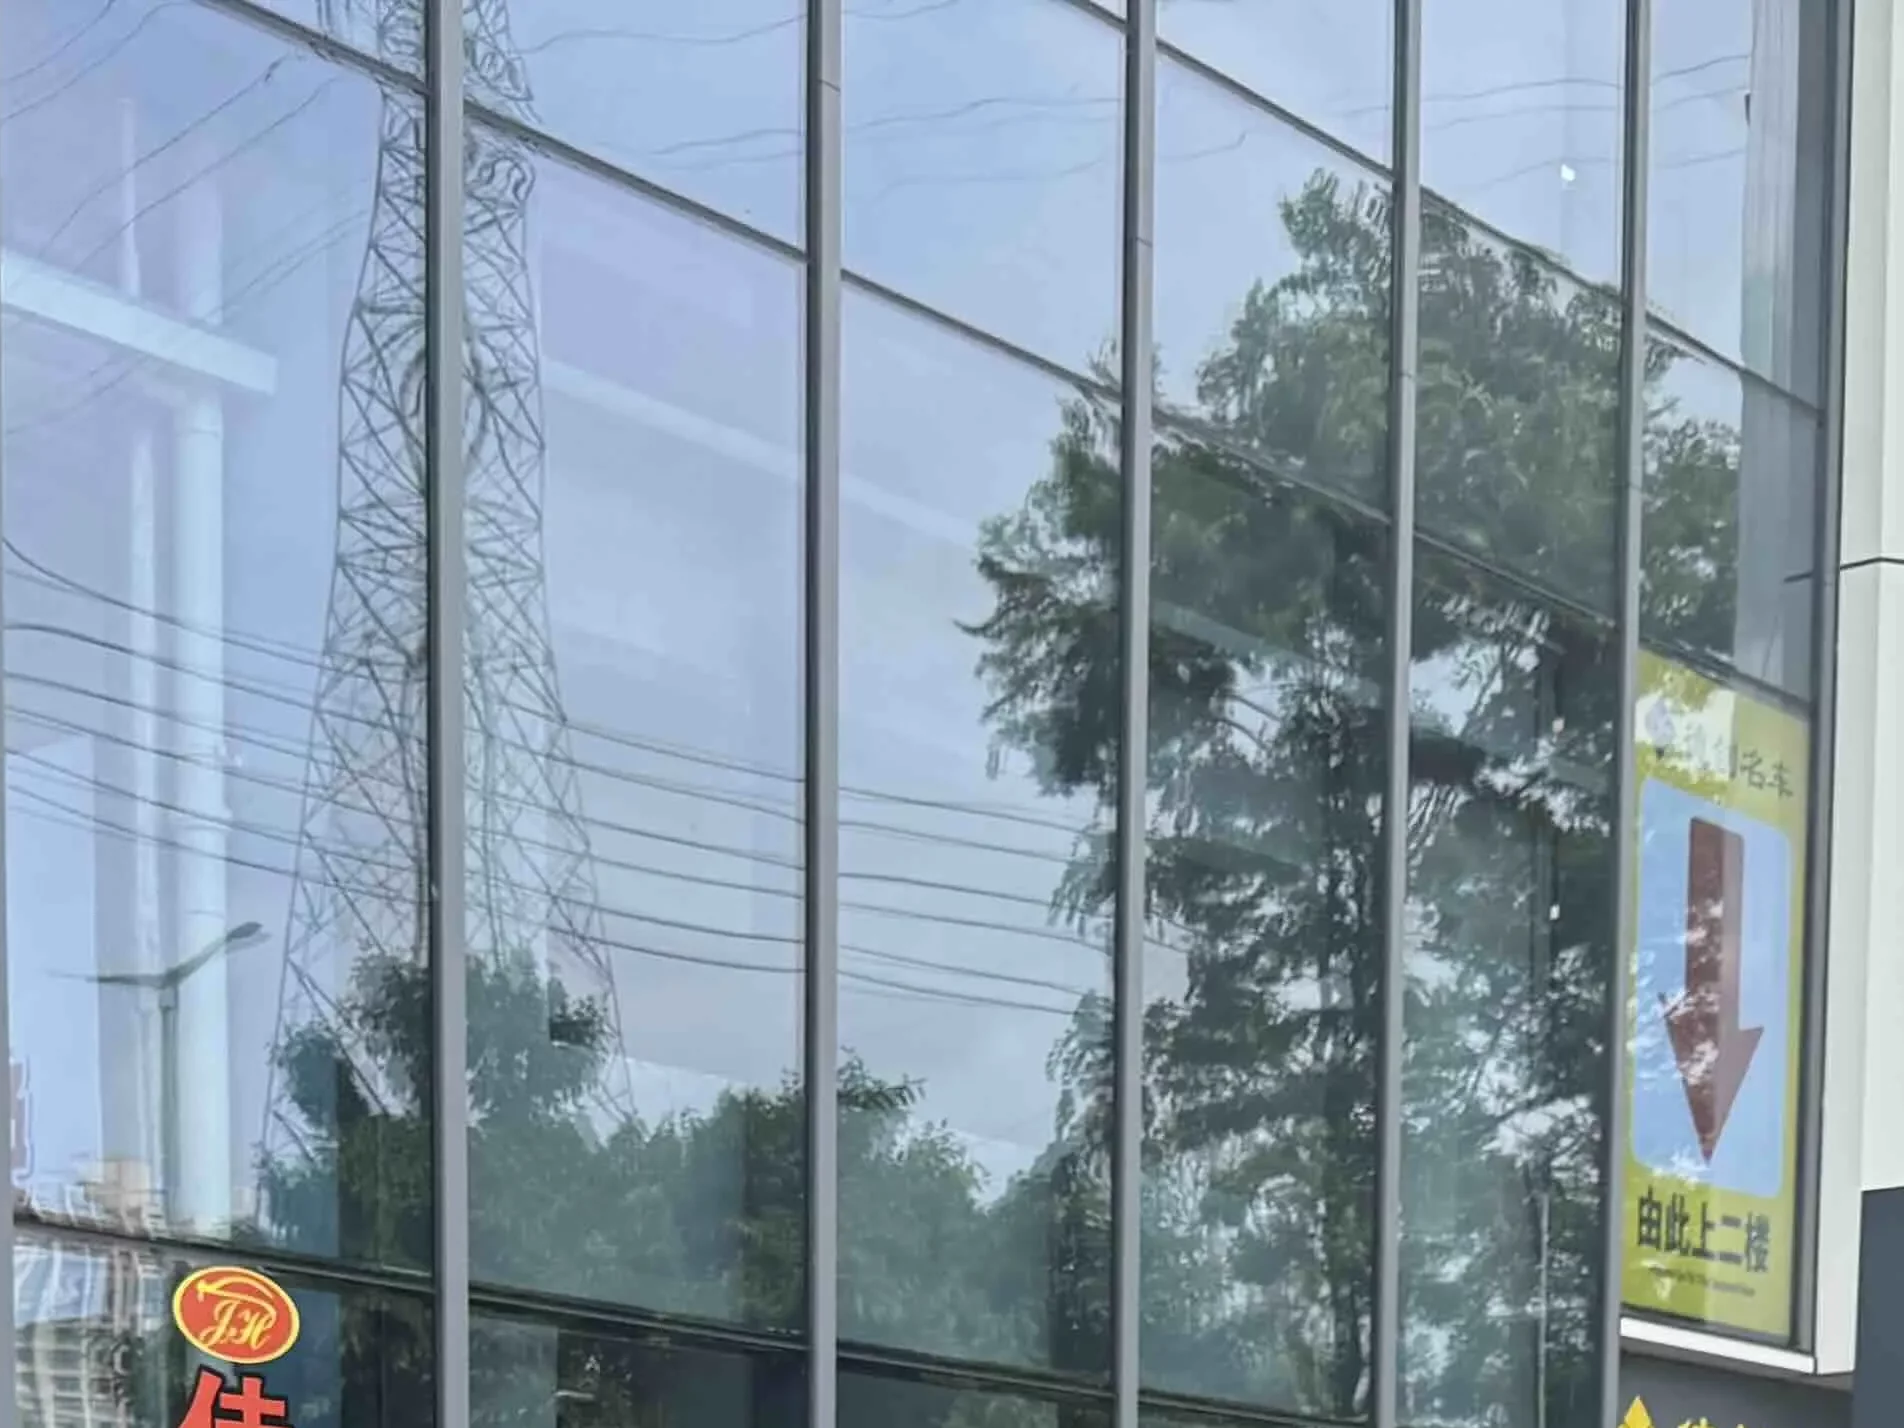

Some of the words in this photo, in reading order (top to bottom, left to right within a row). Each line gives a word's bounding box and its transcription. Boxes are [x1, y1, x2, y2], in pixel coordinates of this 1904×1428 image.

[1638, 1185, 1770, 1273] 由此上二楼
